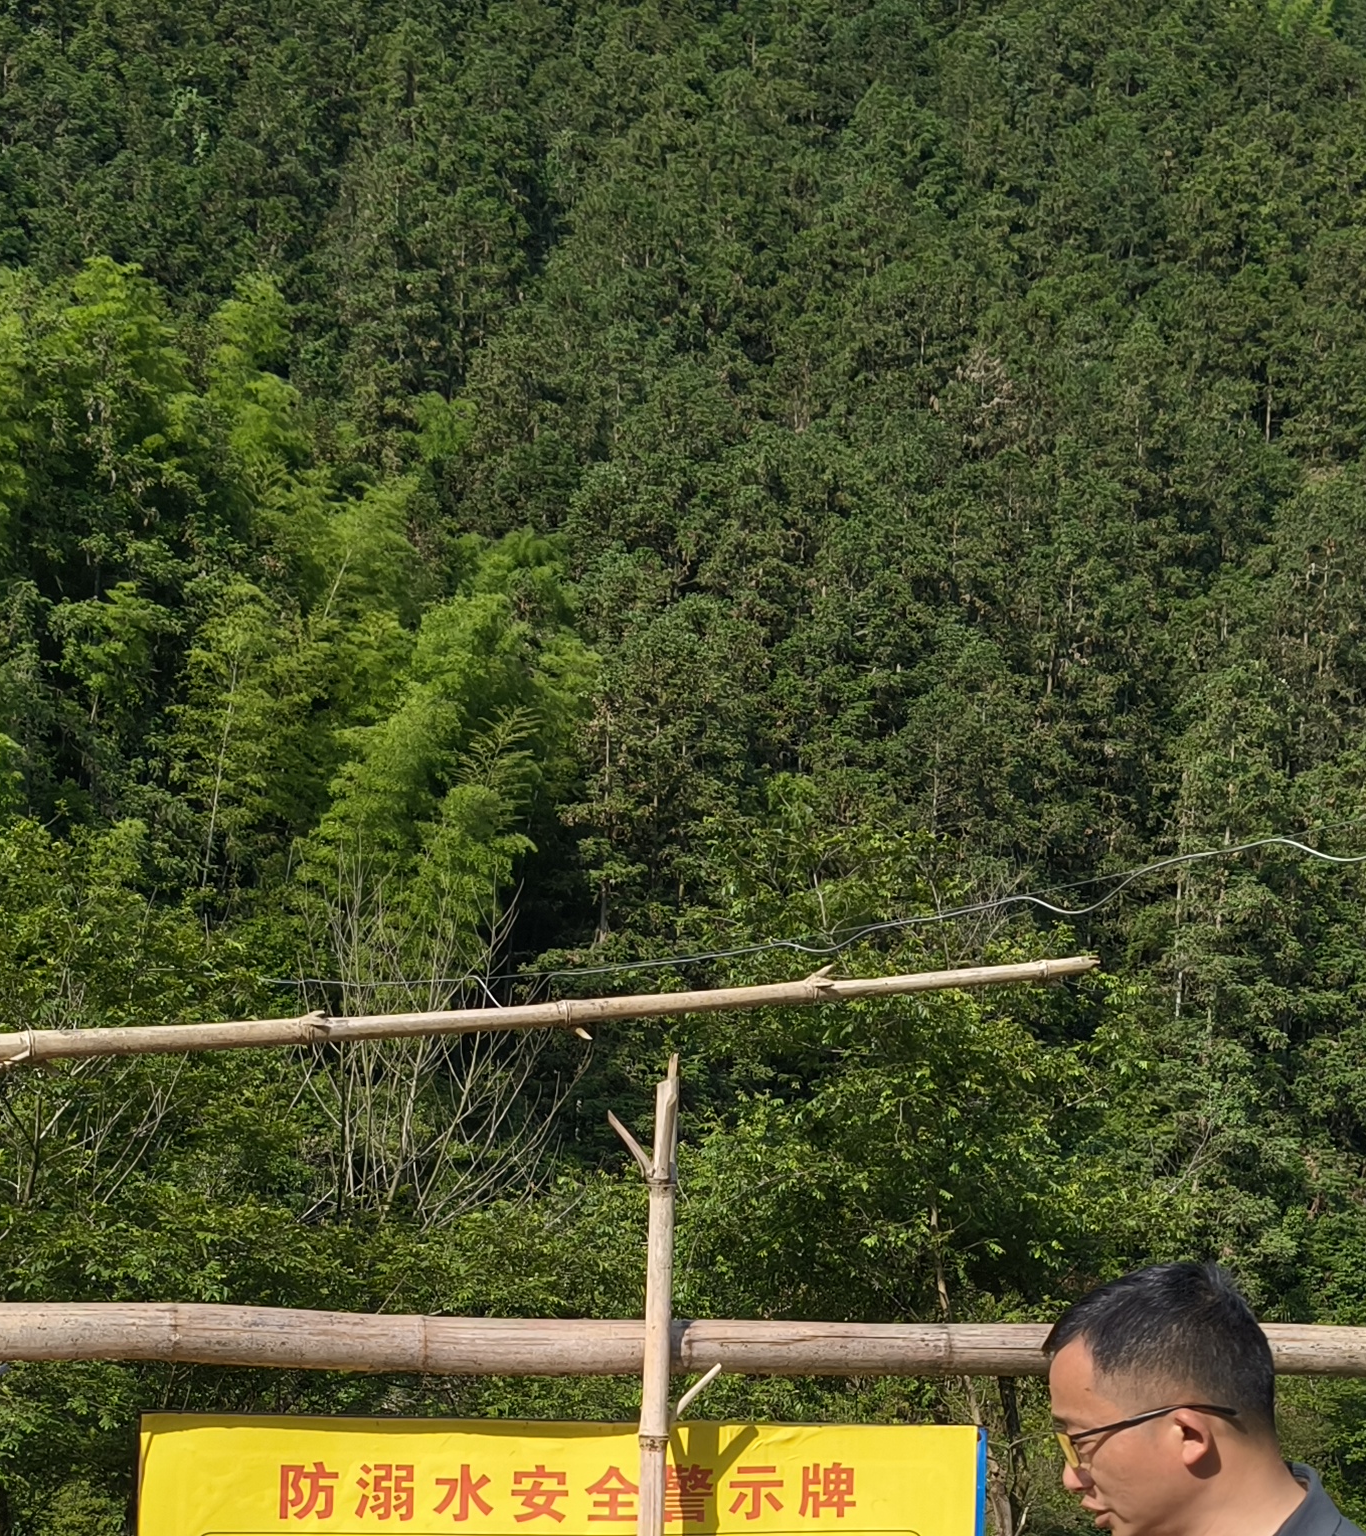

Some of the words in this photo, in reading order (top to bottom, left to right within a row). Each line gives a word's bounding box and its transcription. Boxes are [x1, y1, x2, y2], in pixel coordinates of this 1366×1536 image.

[278, 1461, 857, 1521] 防溺水安全警示牌
